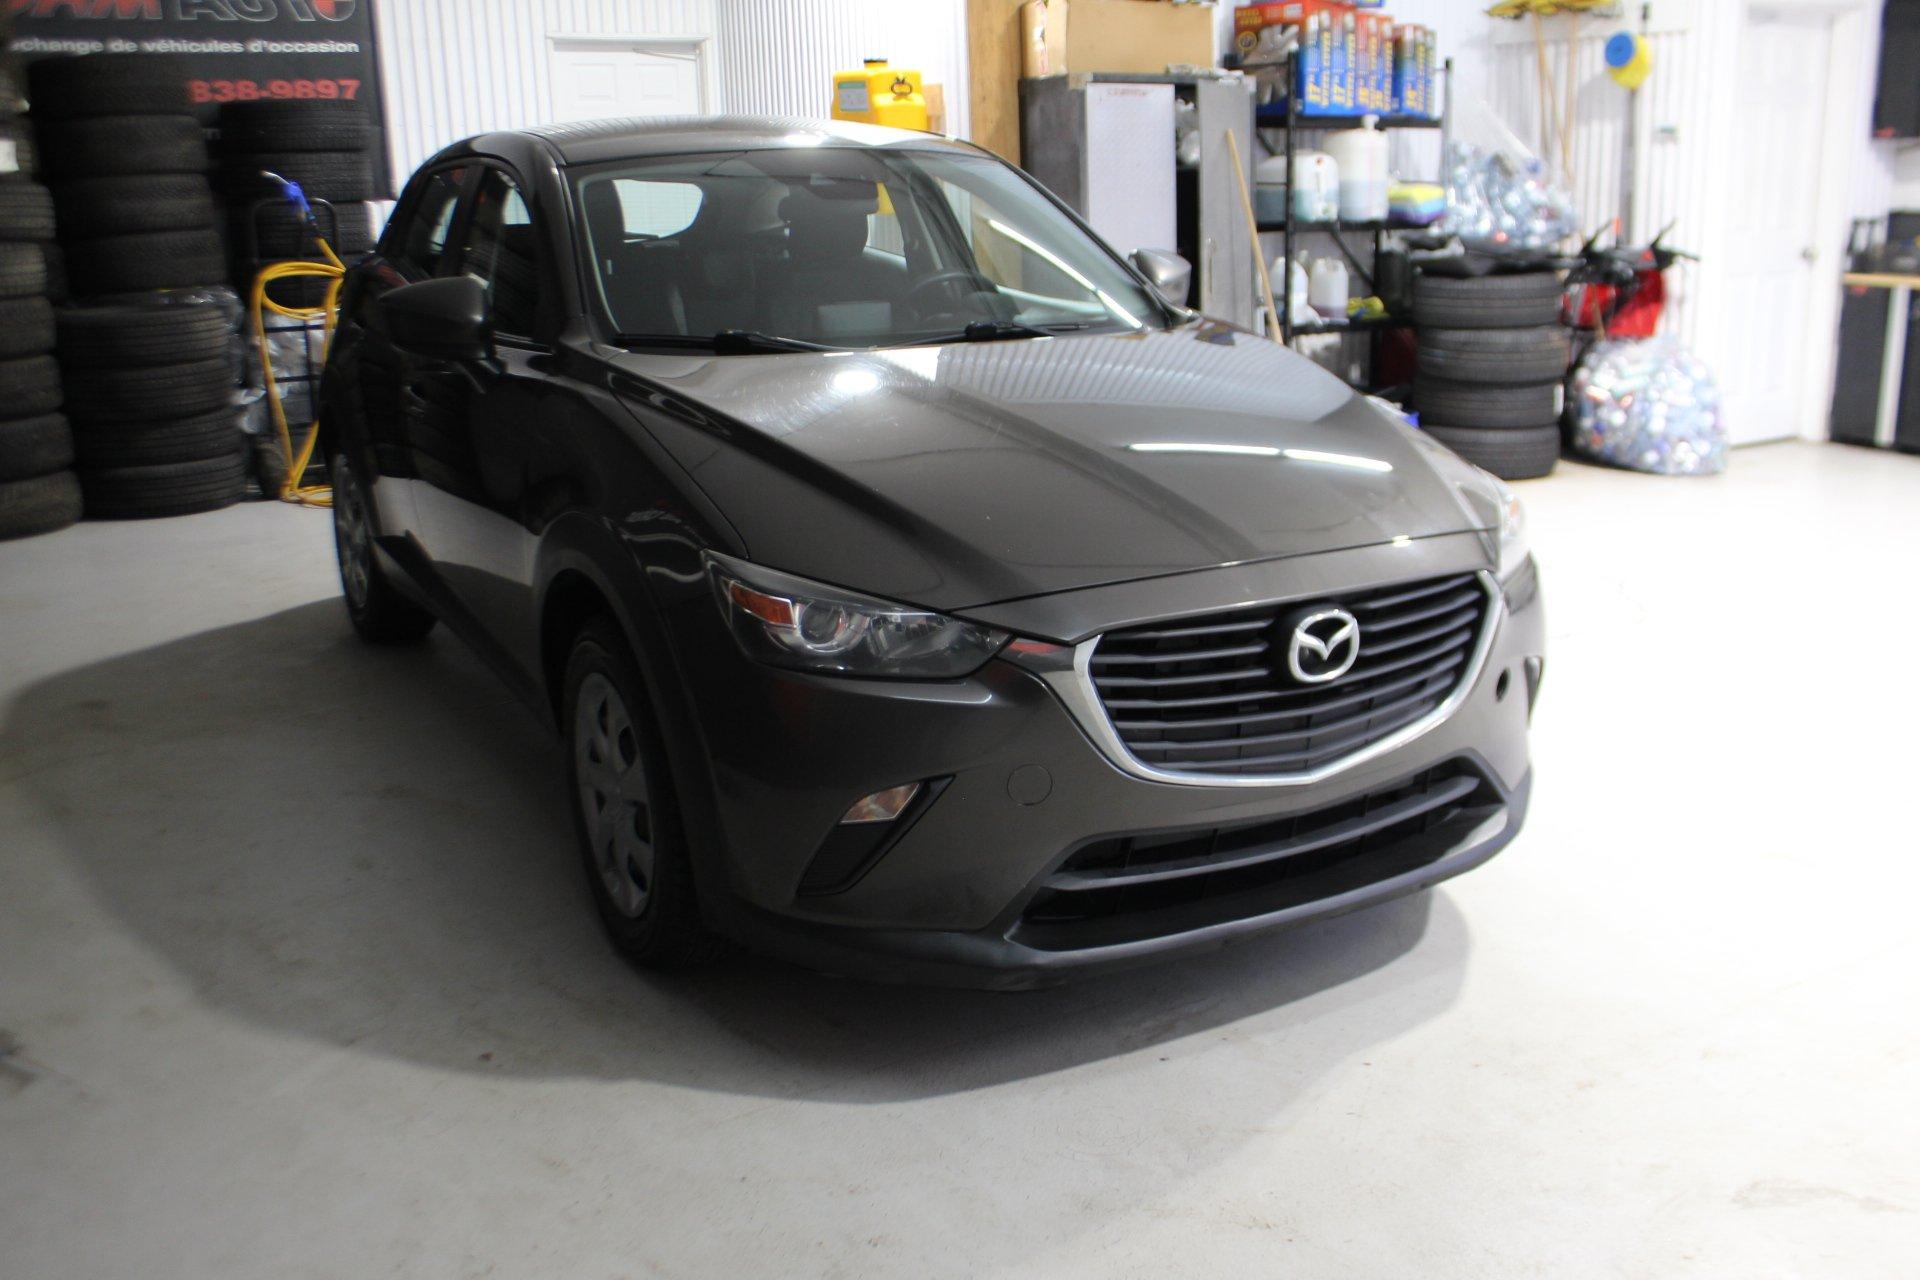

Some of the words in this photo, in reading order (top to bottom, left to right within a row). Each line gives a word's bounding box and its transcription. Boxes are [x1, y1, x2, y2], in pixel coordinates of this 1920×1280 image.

[111, 39, 138, 53] de
[145, 39, 244, 53] véhicules
[250, 39, 360, 53] d'occasion
[189, 79, 361, 102] 838-9897
